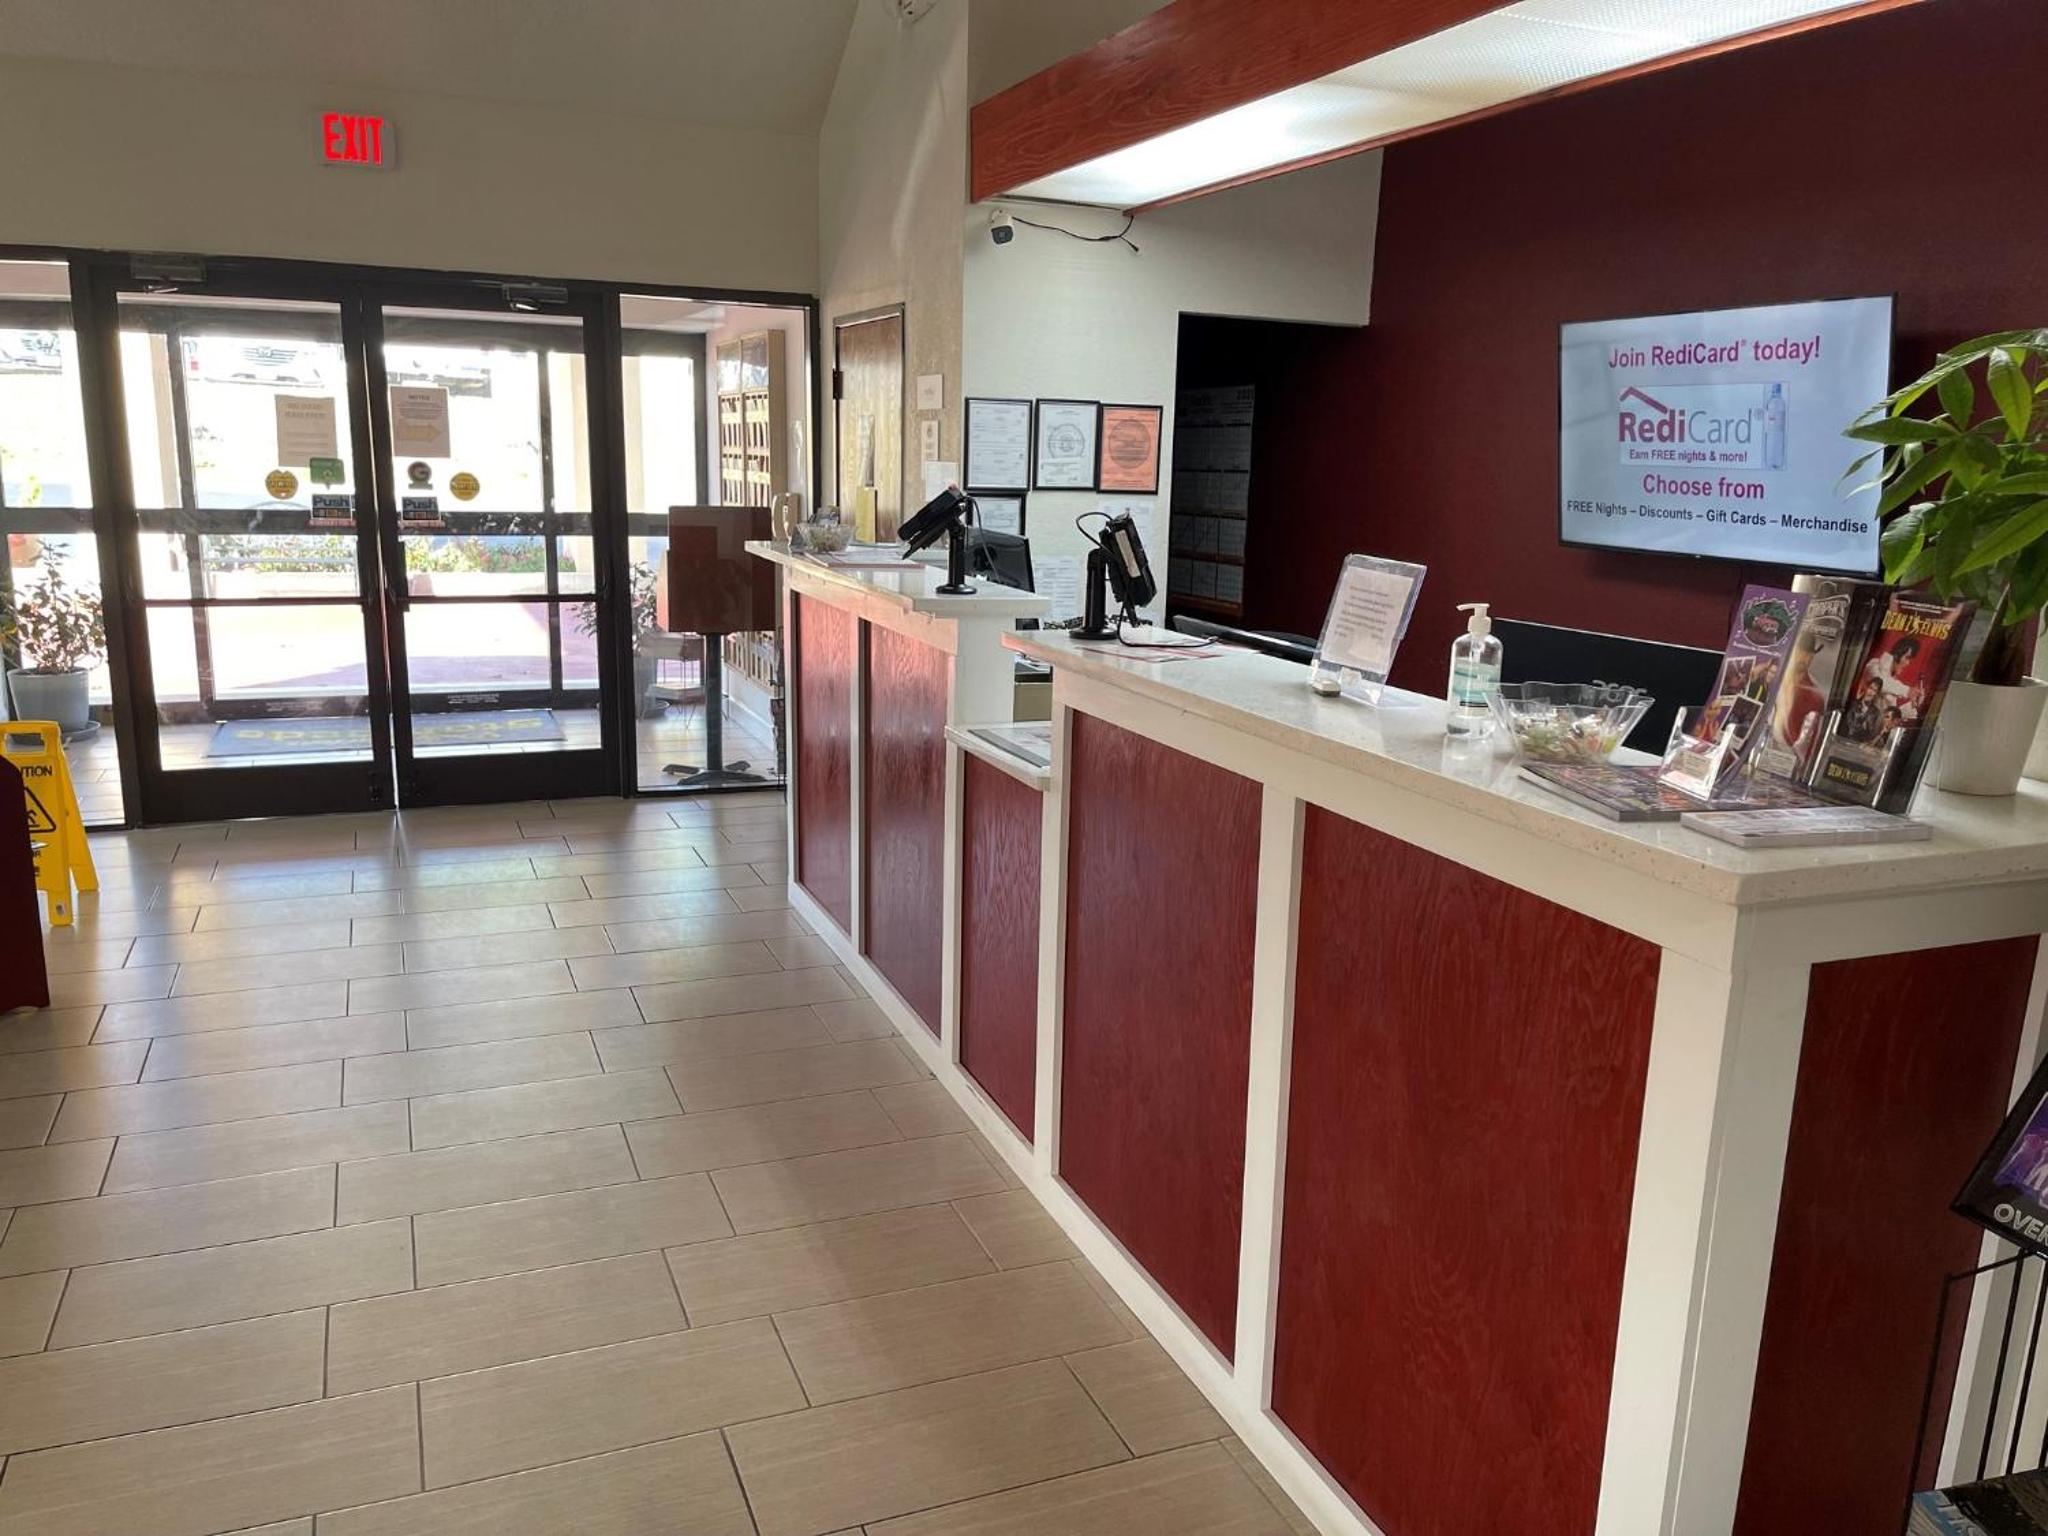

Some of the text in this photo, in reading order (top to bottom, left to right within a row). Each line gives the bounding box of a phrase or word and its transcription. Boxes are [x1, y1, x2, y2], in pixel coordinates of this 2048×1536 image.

[323, 112, 383, 165] EXIT
[1608, 347, 1645, 368] Join
[1753, 335, 1820, 364] today!
[1629, 449, 1748, 463] Earn FREE nights & more!
[1643, 474, 1765, 499] Choose from
[313, 495, 350, 507] Push
[403, 497, 438, 509] Push
[1567, 500, 1593, 513] FREE
[1596, 502, 1627, 517] Nights
[1639, 504, 1693, 521] Discounts
[1706, 509, 1727, 523] Gift
[1730, 511, 1766, 526] Cards
[1781, 514, 1868, 533] Merchandise
[20, 764, 53, 777] TION
